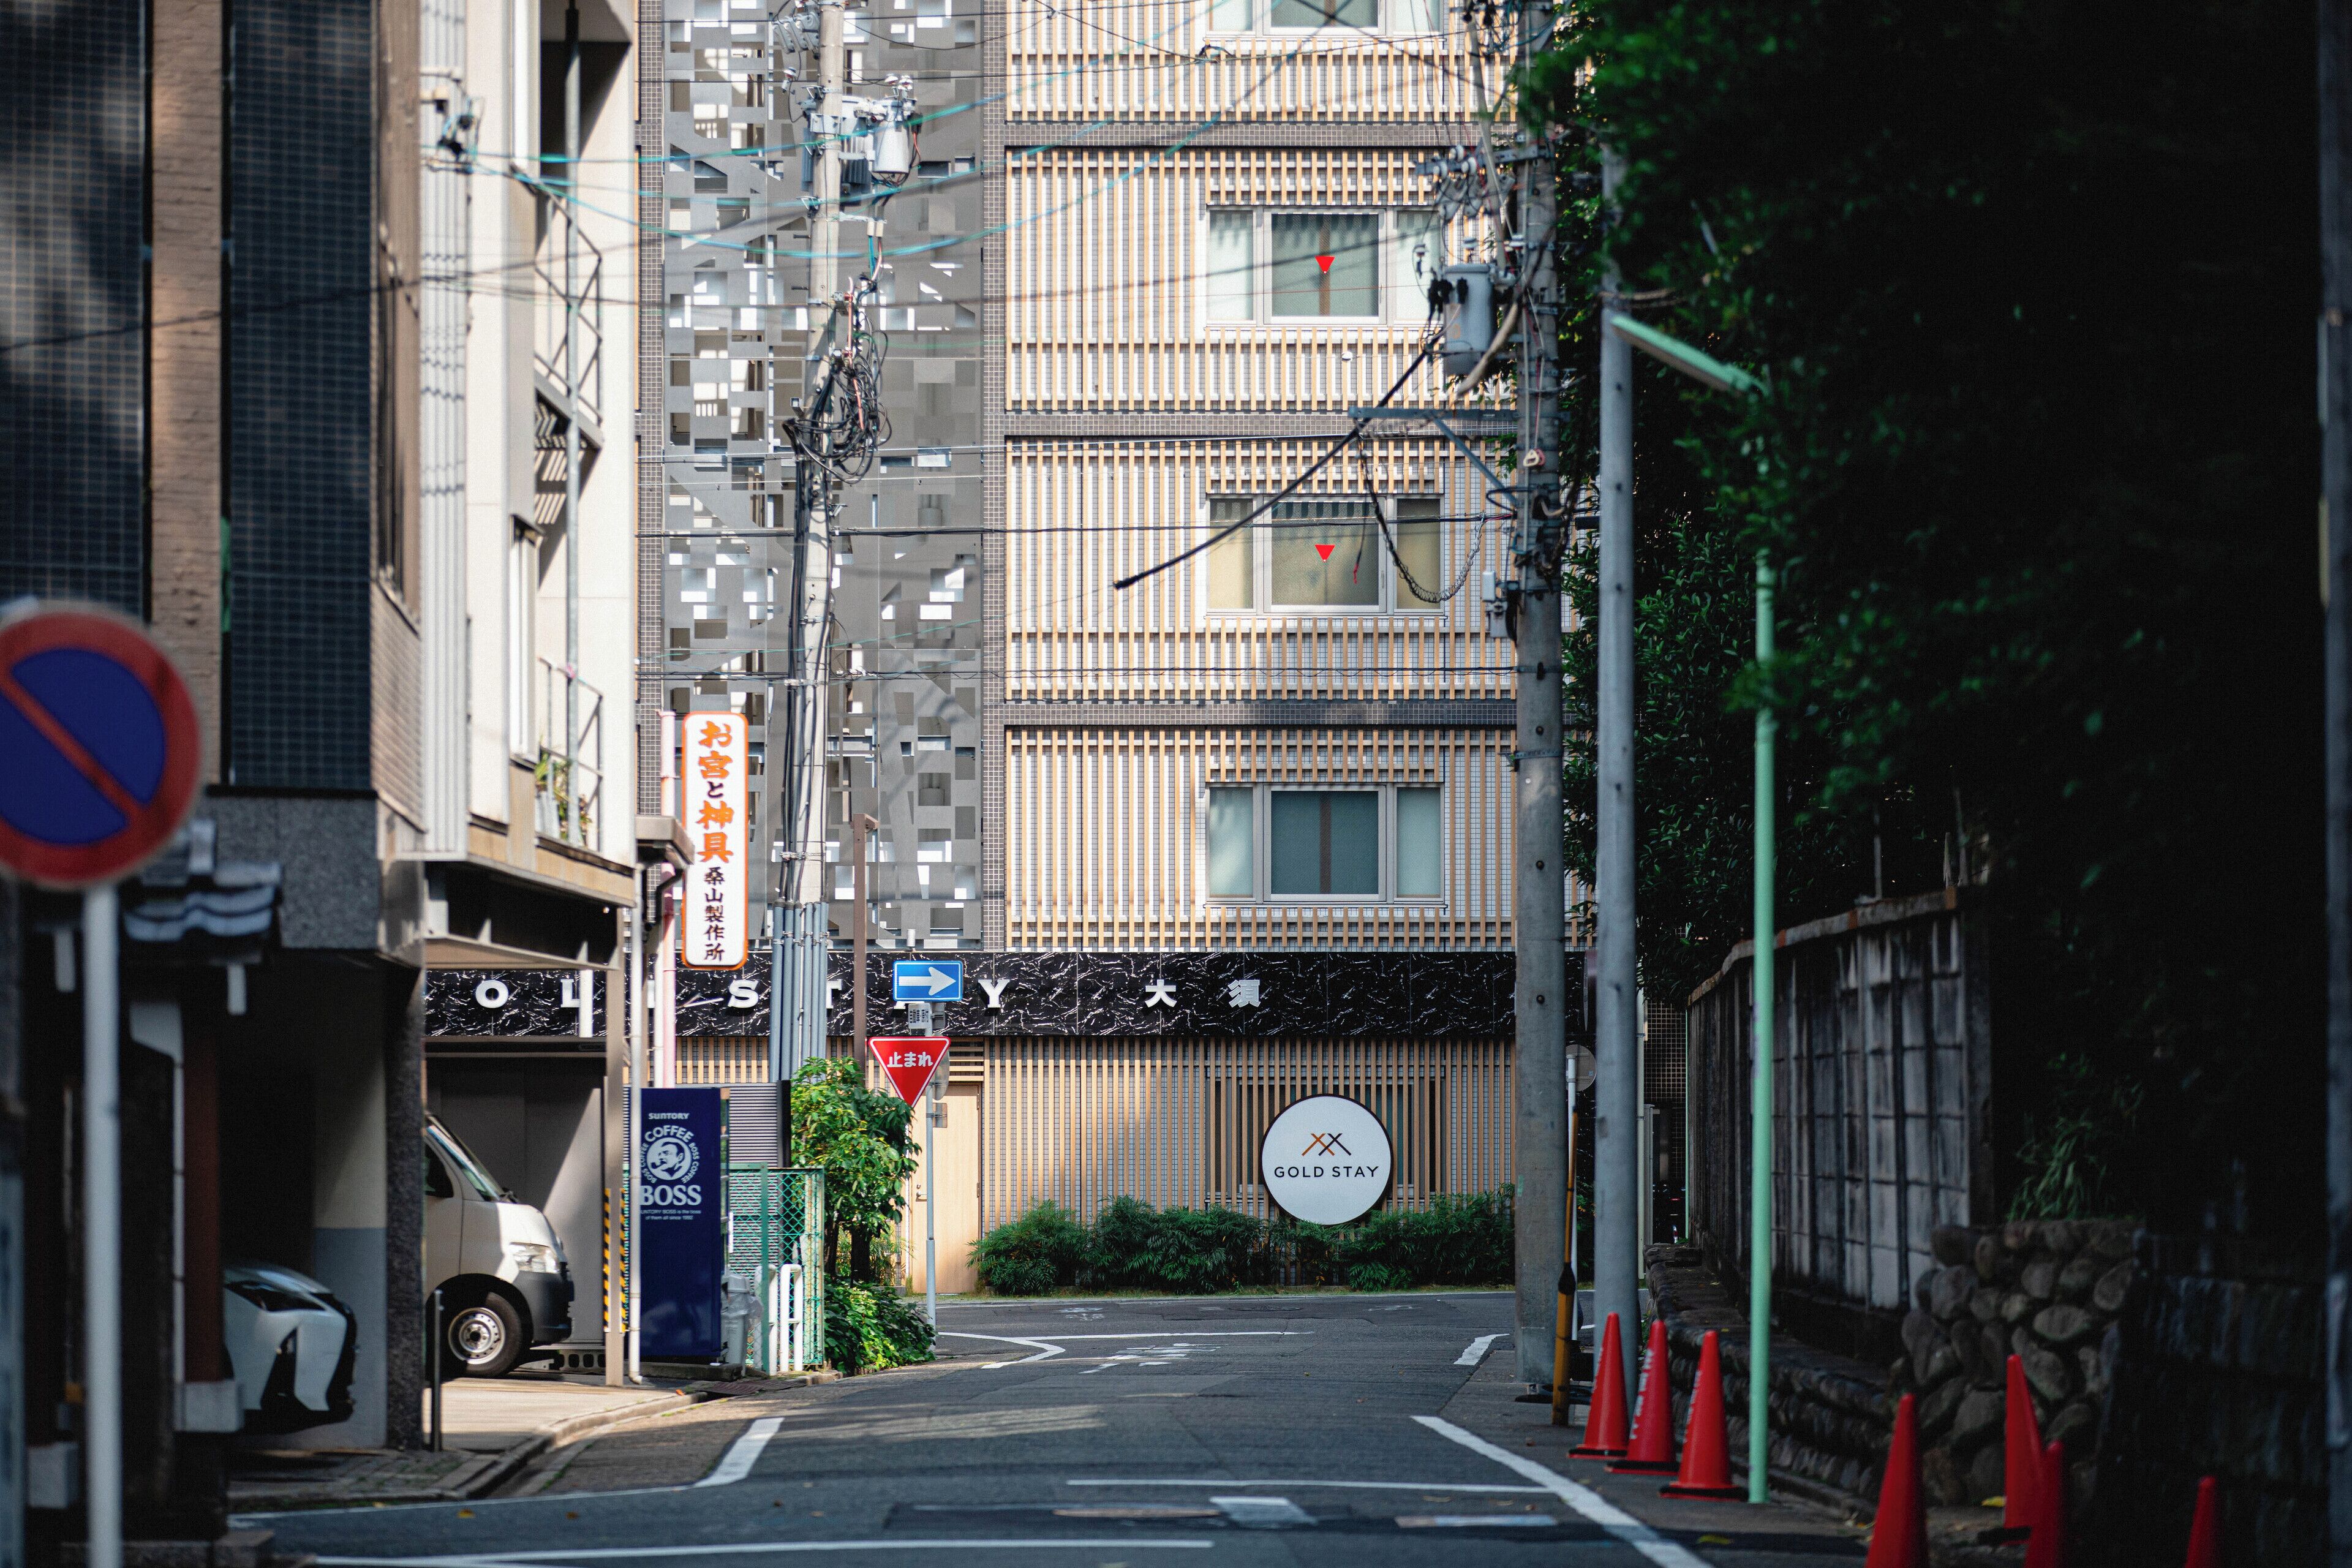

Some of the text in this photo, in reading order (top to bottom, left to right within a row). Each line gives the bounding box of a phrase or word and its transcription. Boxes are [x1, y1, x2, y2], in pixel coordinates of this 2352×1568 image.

[696, 720, 734, 962] お宮と神具 桑山製作所
[1145, 978, 1261, 1008] 大須
[886, 1051, 933, 1068] 止まれ
[644, 1125, 695, 1143] COFFEE
[680, 1142, 700, 1184] BOSS COFFEE
[1274, 1166, 1379, 1178] GOLD STAY
[641, 1167, 658, 1183] BOSS
[640, 1184, 702, 1206] BOSS
